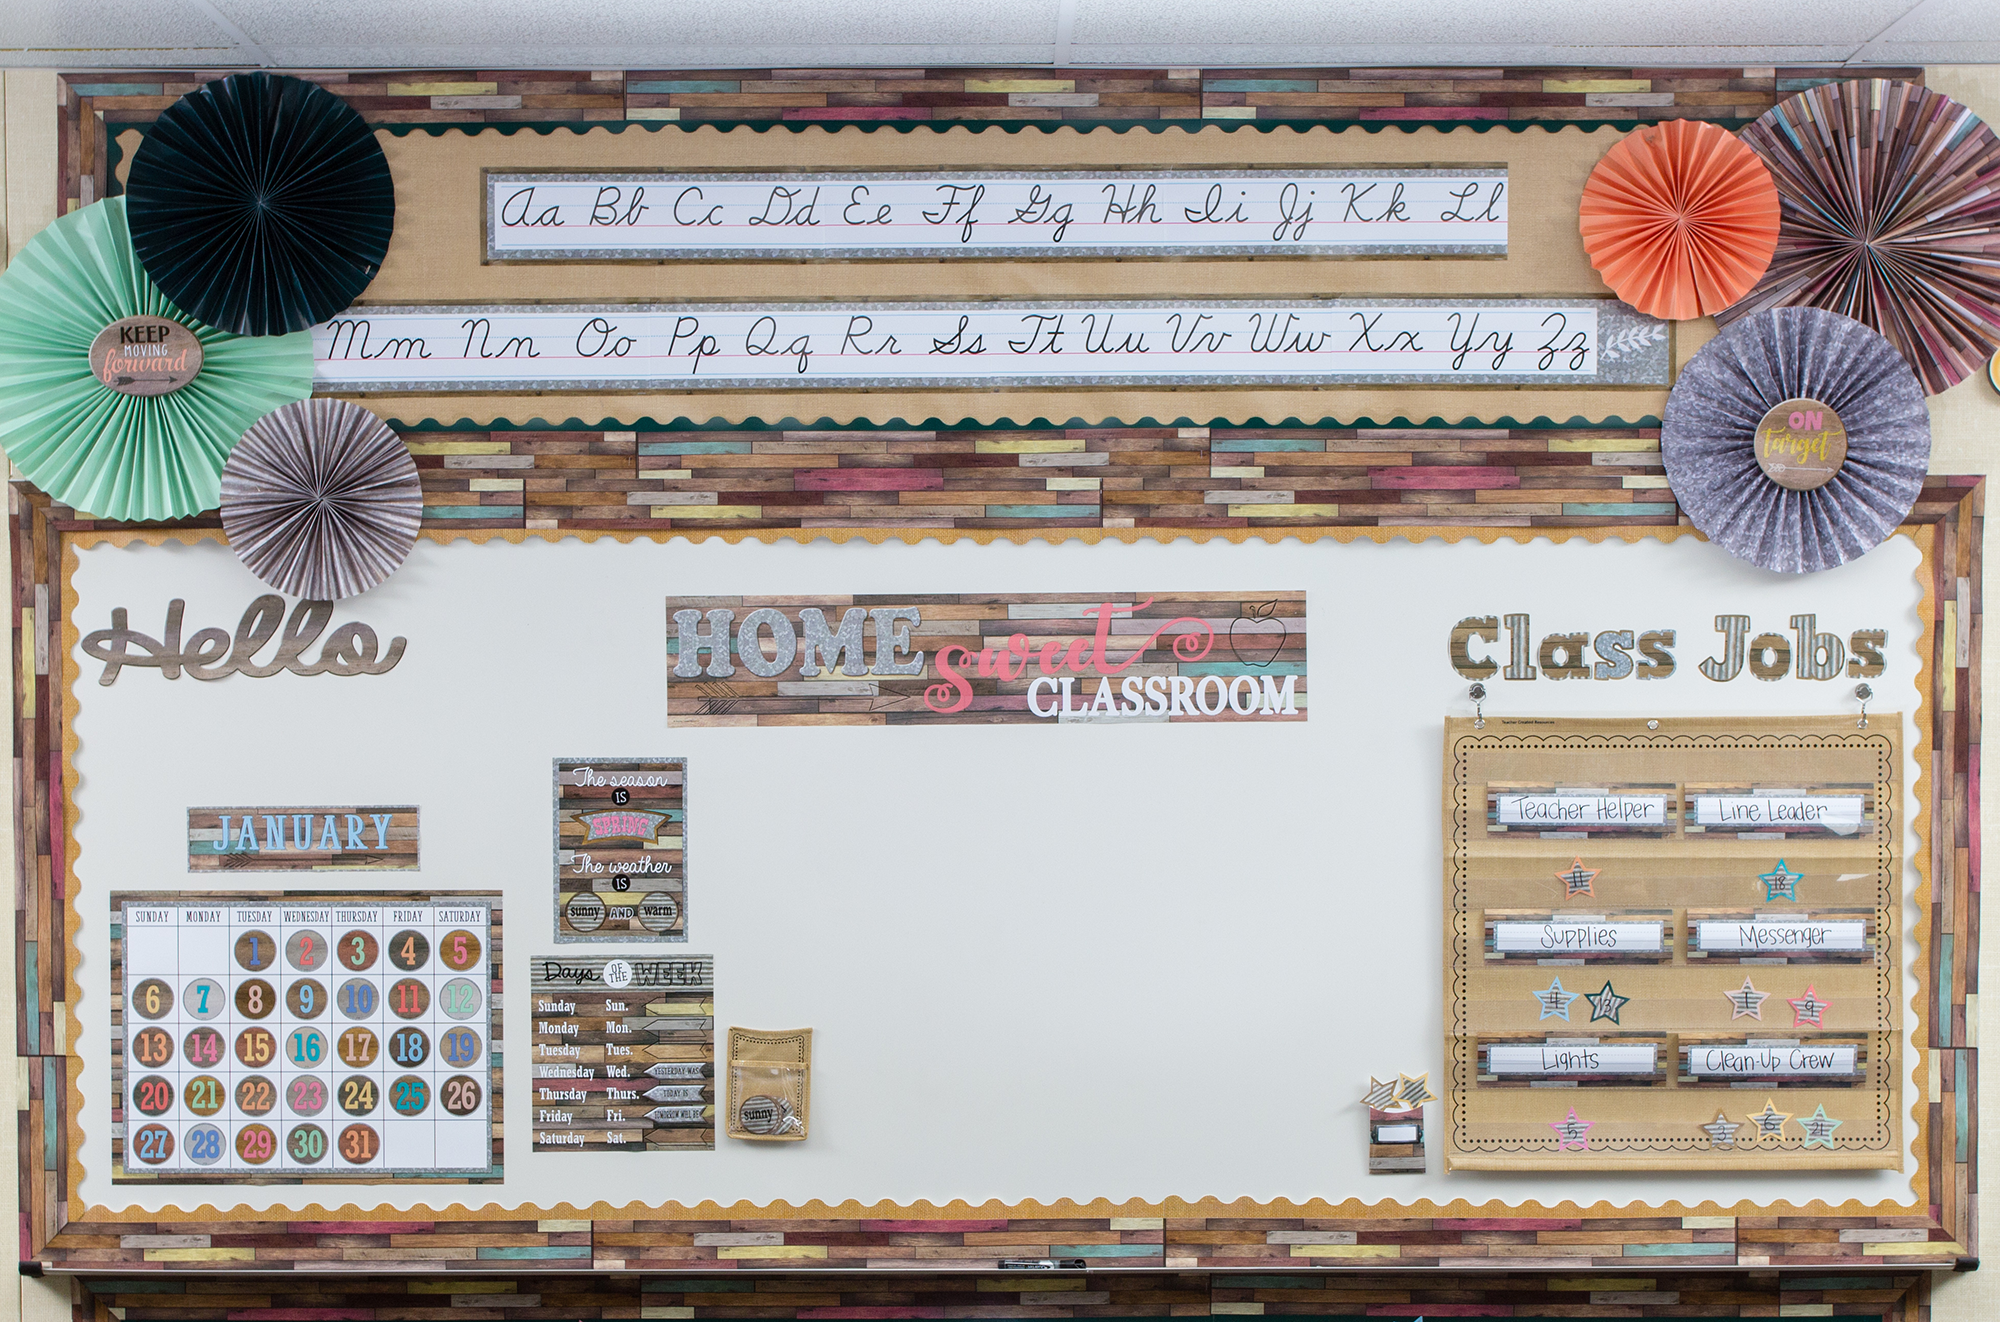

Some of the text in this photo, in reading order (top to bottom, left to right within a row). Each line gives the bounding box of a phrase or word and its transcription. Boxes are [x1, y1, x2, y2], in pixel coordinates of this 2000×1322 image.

[120, 325, 170, 344] KEEP
[124, 343, 168, 358] MOVING
[103, 348, 189, 383] forward
[1788, 410, 1824, 431] ON
[1761, 426, 1842, 465] target
[80, 594, 407, 687] Hello
[672, 606, 925, 678] HOME
[1448, 613, 1888, 682] Class Jobs
[923, 596, 1214, 714] Sweet
[1027, 675, 1299, 717] CLASSROOM
[572, 766, 668, 788] The season
[615, 791, 627, 804] IS
[1511, 795, 1654, 821] Teacher Helper
[1719, 799, 1828, 822] Line Leader
[213, 813, 393, 851] JANUARY
[592, 815, 649, 836] SPRING
[570, 853, 672, 874] The weather
[615, 878, 627, 890] IS
[1572, 871, 1584, 887] 11
[1774, 875, 1786, 890] 18
[135, 911, 481, 923] SUNDAY MONDAY TUESDAY WEDNESDAY THURSDAY FRIDAY SATURDAY
[570, 906, 673, 921] sunny AND warm
[1540, 924, 1617, 949] Supplies
[1739, 925, 1832, 948] Messenger
[249, 937, 468, 966] 1 2 3 4 5
[542, 961, 703, 986] Days OF THE WEEK
[145, 985, 474, 1013] 6 7 8 9 10 11 12
[538, 999, 629, 1015] Sunday Sun.
[1550, 992, 1560, 1009] 4
[1599, 997, 1612, 1013] 13
[1804, 1000, 1814, 1017] 9
[538, 1020, 632, 1037] Monday Mon.
[141, 1033, 474, 1062] 13 14 15 16 17 18 19
[538, 1043, 634, 1059] Tuesday Tues.
[1541, 1048, 1600, 1071] Lights
[1705, 1049, 1835, 1072] Clean-Up Crew
[538, 1064, 631, 1081] Wednesday Wed.
[653, 1067, 699, 1075] YESTERDAY WAS
[140, 1081, 476, 1110] 20 21 22 23 24 25 26
[539, 1086, 640, 1103] Thursday Thurs.
[663, 1089, 681, 1097] TODAY
[539, 1109, 626, 1125] Friday Fri.
[654, 1110, 679, 1119] TOMORROW
[692, 1110, 699, 1118] BE
[743, 1109, 774, 1123] sunny
[1764, 1114, 1776, 1131] 6
[1567, 1123, 1578, 1140] 5
[1717, 1125, 1727, 1141] 3
[1811, 1121, 1824, 1136] 21
[140, 1130, 372, 1159] 27 28 29 30 31
[539, 1130, 627, 1147] Saturday Sat.
